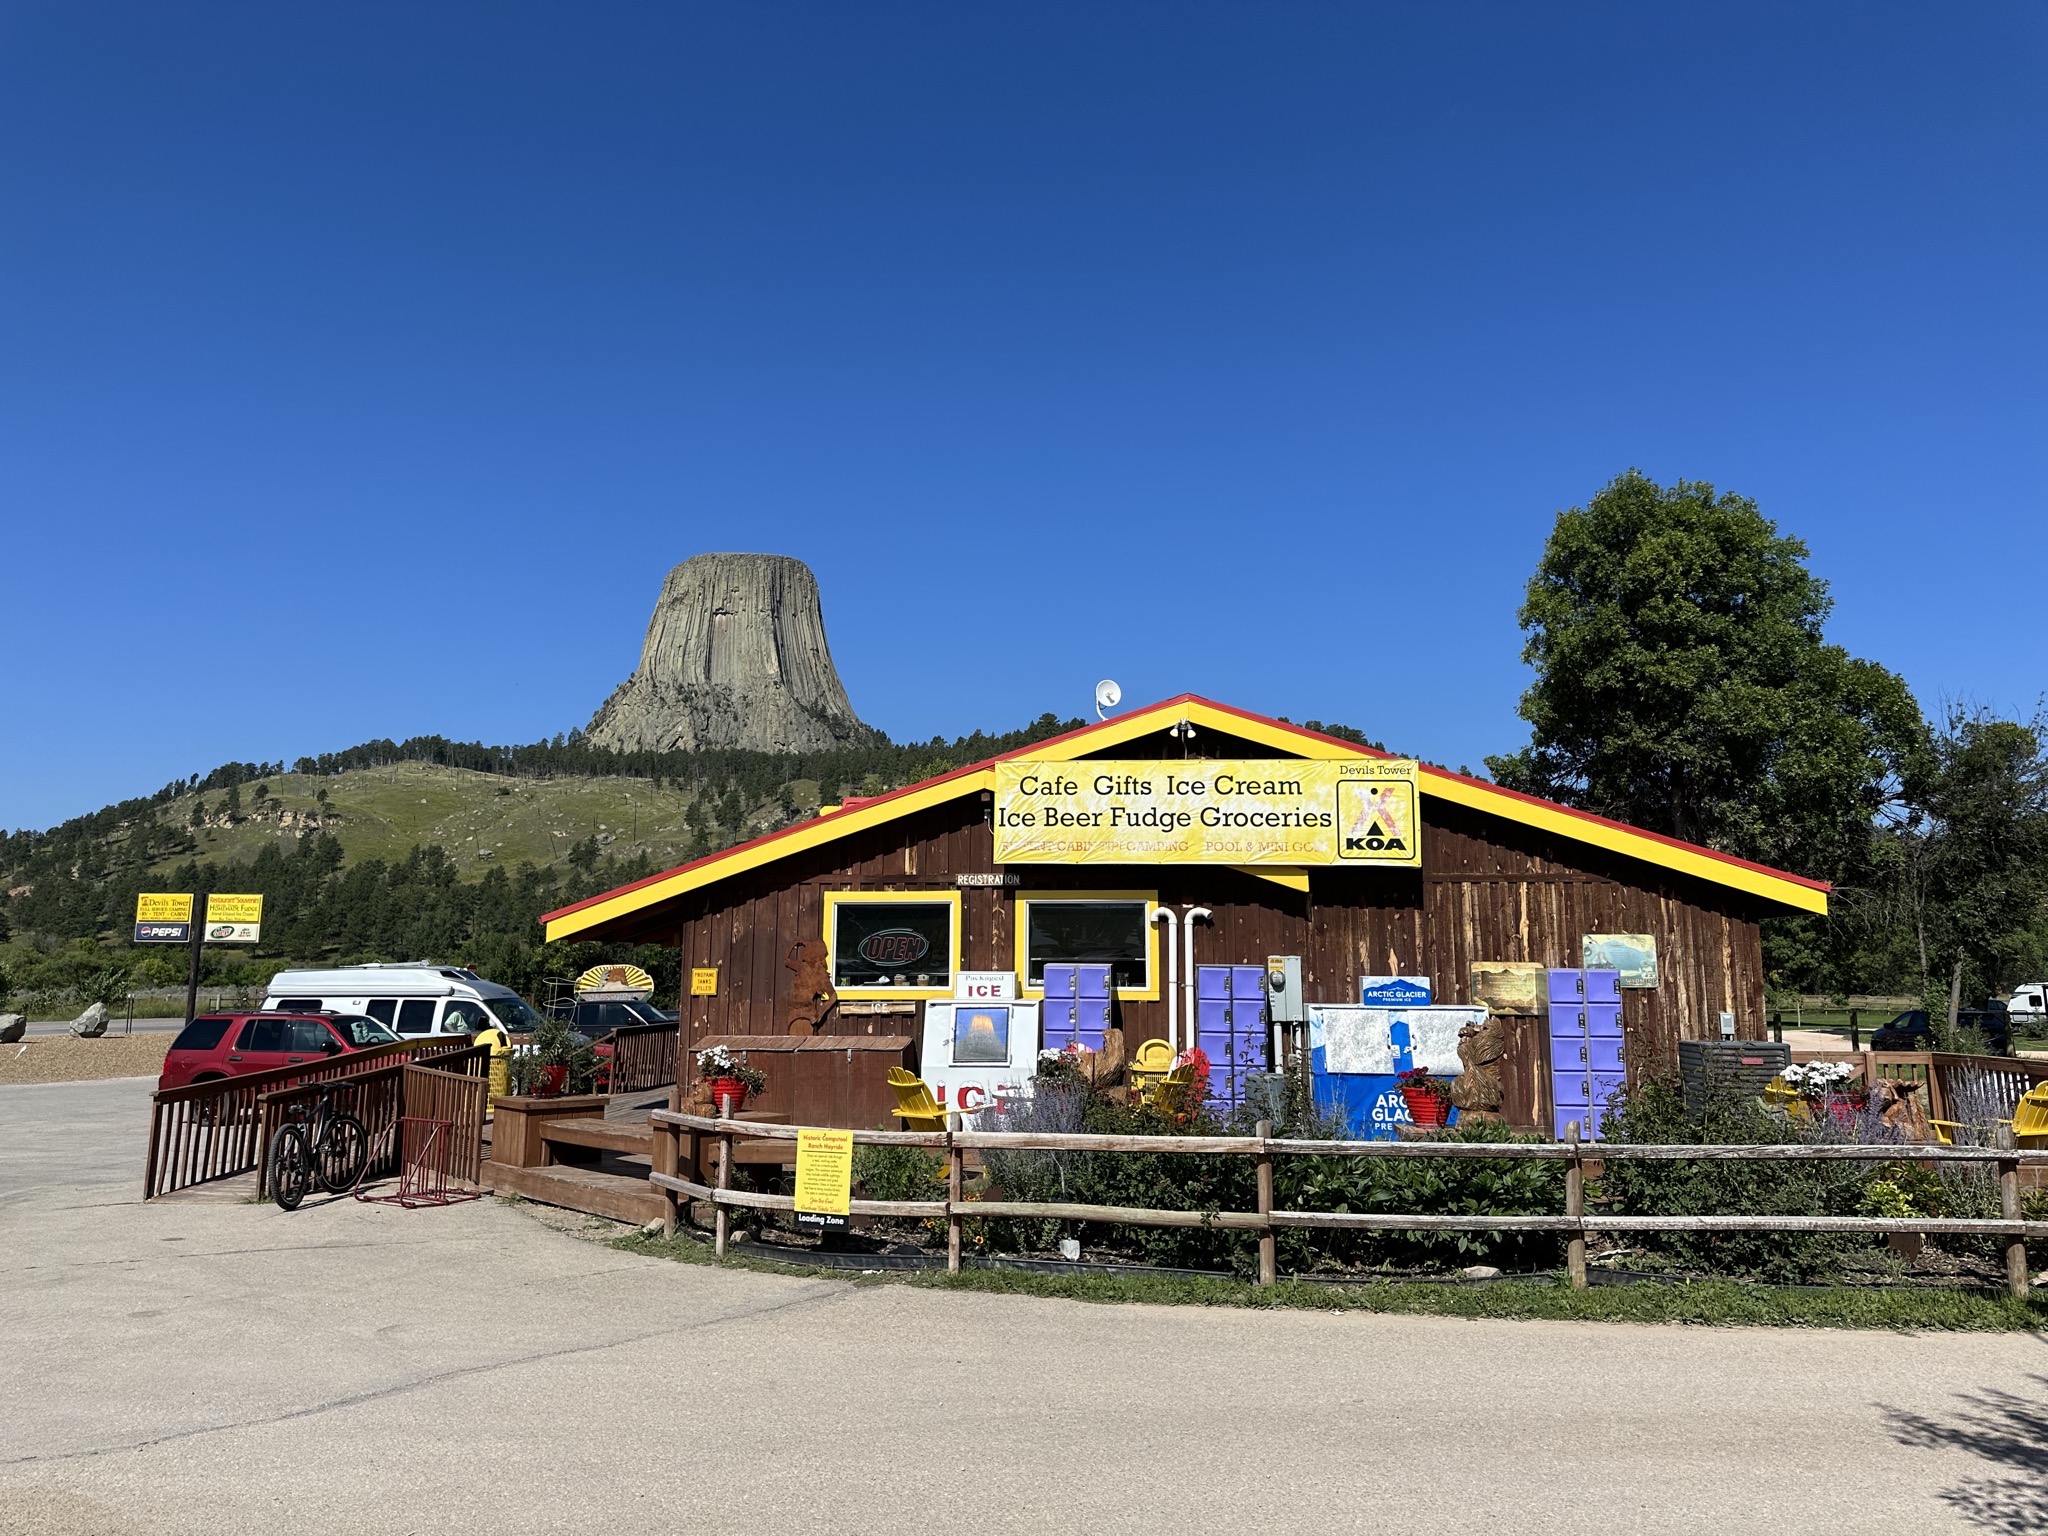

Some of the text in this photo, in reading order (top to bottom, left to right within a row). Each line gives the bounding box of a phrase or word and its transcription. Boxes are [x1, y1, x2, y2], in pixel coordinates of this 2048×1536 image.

[1339, 765, 1412, 775] Devils Tower
[1019, 775, 1303, 796] Cafe Gifts Ice Cream
[998, 806, 1332, 833] Ice Beer Fudge Groceries
[1126, 841, 1189, 852] CAMPING
[1205, 841, 1243, 852] POOL
[1246, 842, 1254, 852] &
[1258, 841, 1289, 852] MINI
[1346, 837, 1407, 851] KOA
[957, 874, 1020, 885] REGISTRATION
[151, 927, 182, 937] PEPSI
[866, 936, 921, 960] OPEN
[968, 985, 1001, 997] ICE
[870, 1003, 890, 1013] ICE
[798, 1213, 845, 1226] Loading Zone
